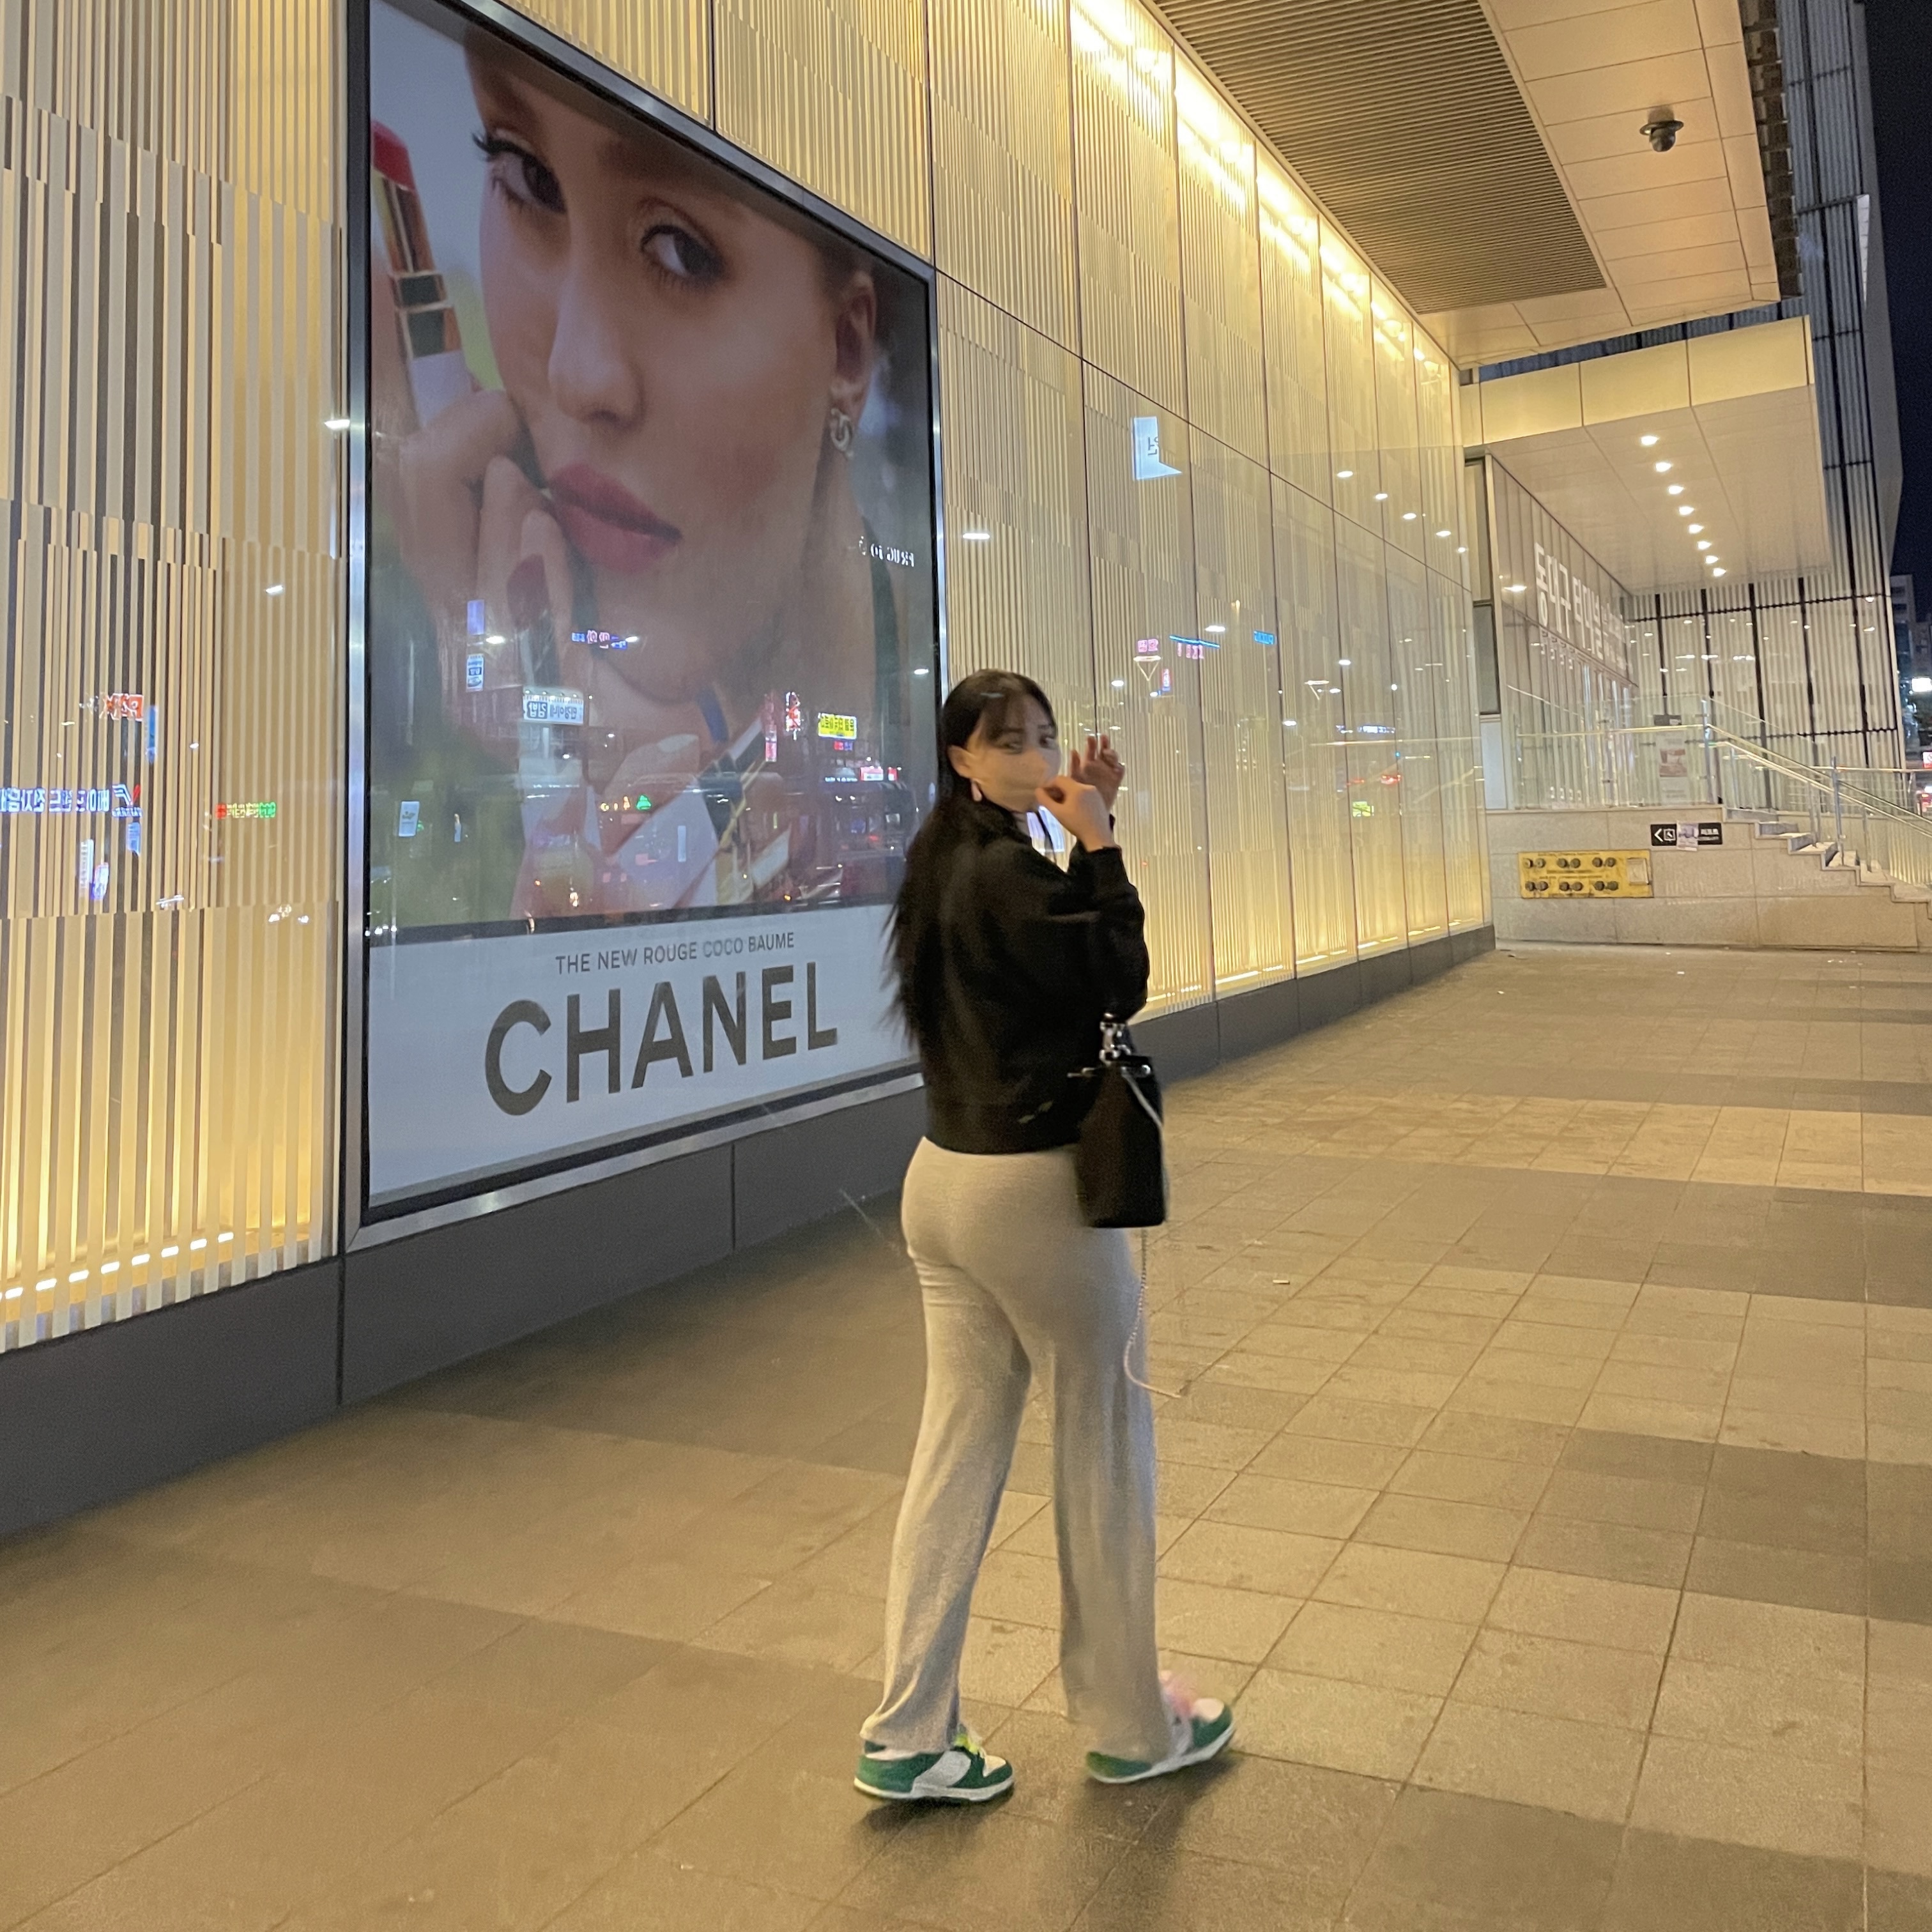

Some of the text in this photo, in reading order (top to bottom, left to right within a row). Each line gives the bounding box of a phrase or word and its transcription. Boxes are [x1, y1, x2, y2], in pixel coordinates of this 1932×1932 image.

[1535, 542, 1571, 639] 동대구
[556, 931, 795, 975] THE NEW ROUGE COCO BAUME
[484, 962, 838, 1116] CHANEL
